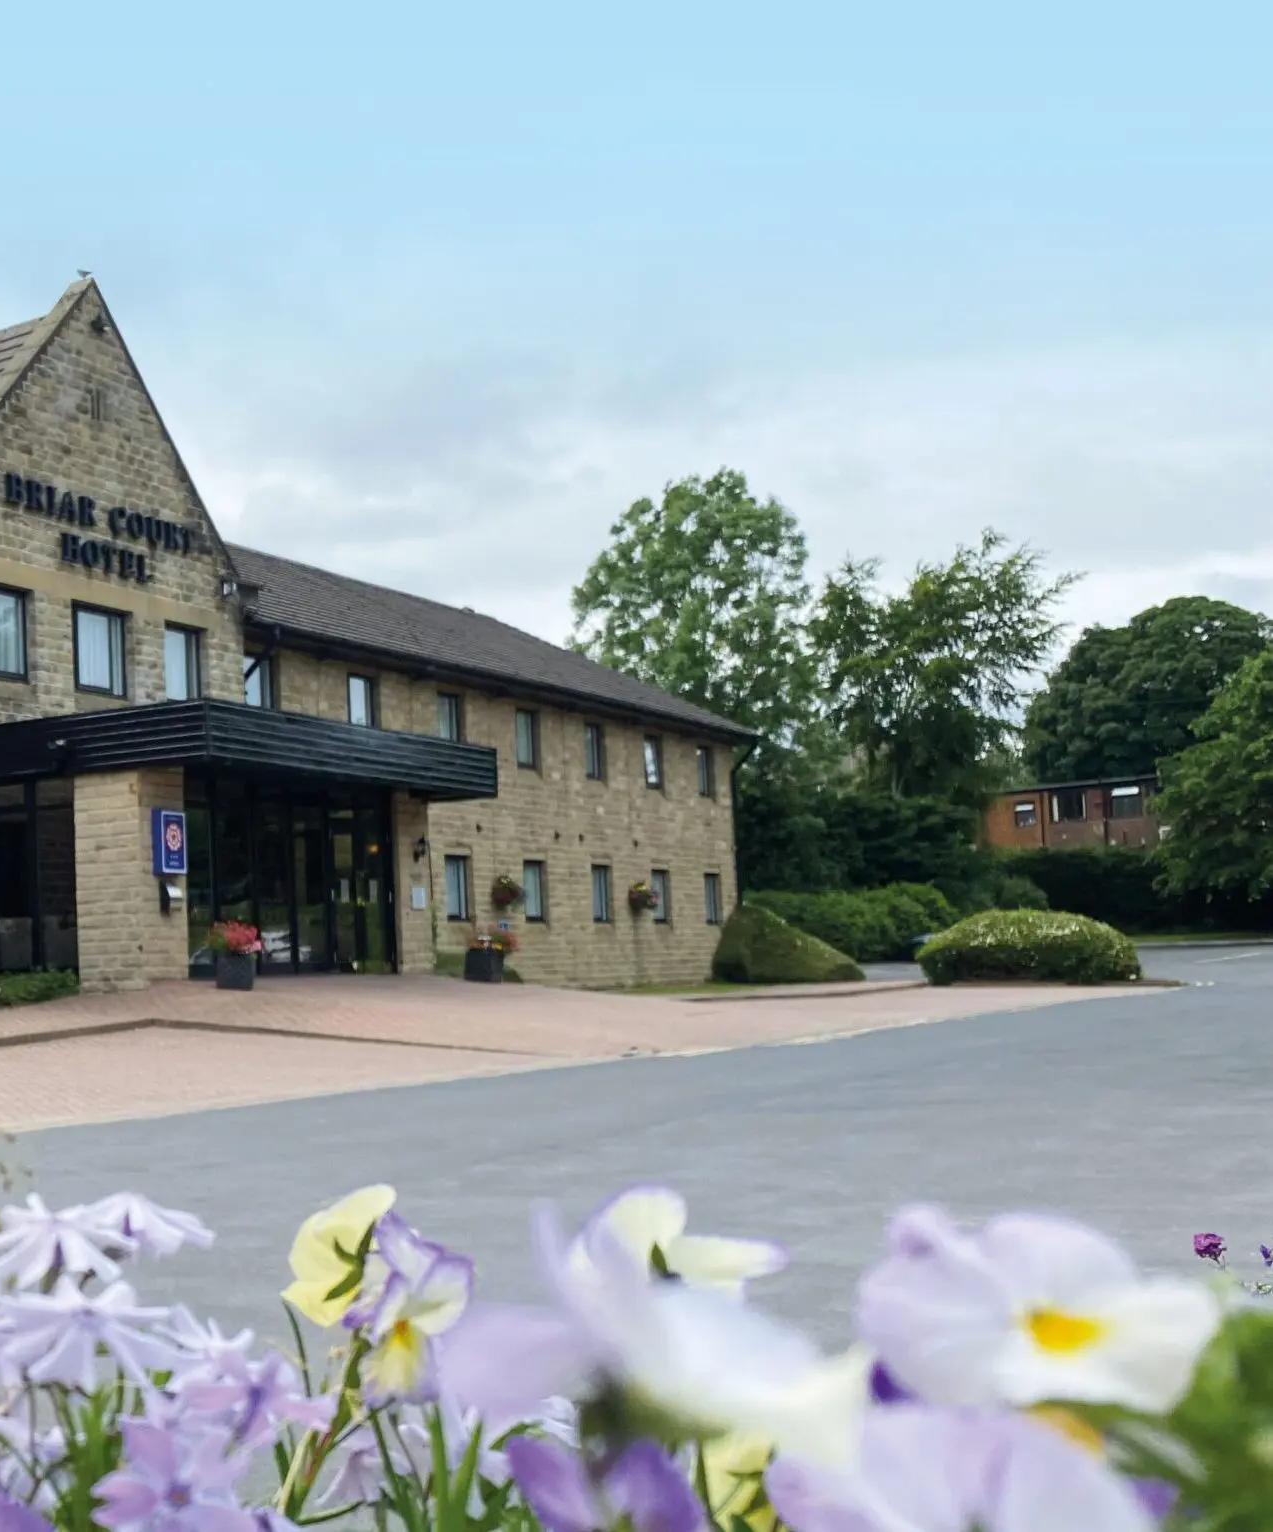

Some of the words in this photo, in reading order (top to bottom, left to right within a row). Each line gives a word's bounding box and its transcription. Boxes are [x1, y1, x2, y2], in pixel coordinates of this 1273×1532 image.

[5, 472, 96, 527] BRIAR
[107, 507, 194, 553] COURT
[61, 533, 154, 583] HOTEL
